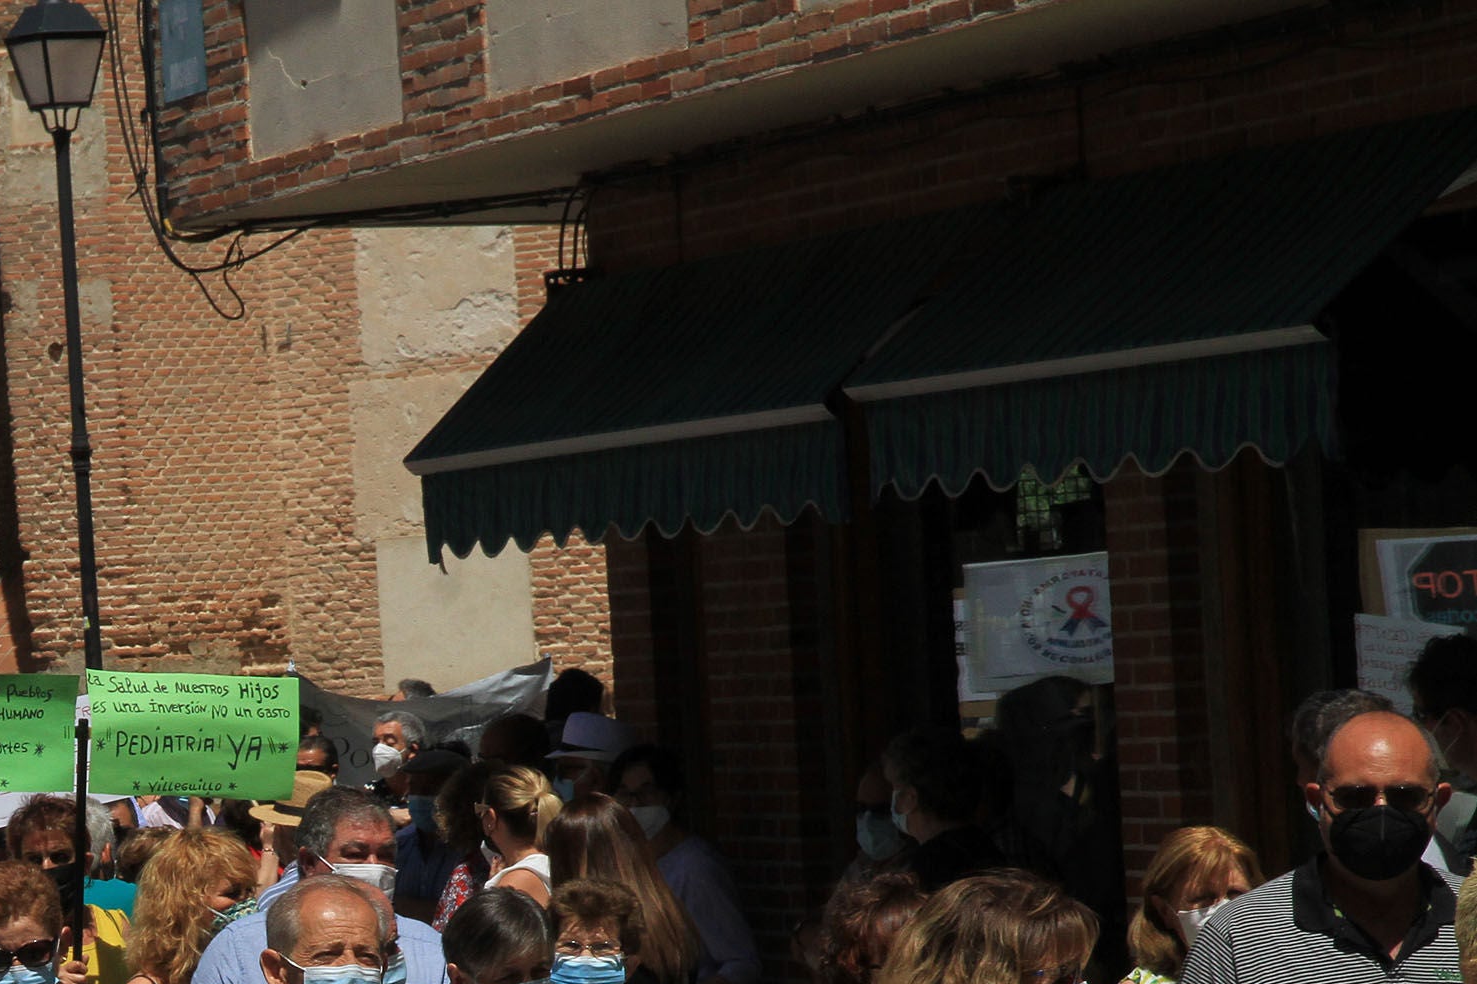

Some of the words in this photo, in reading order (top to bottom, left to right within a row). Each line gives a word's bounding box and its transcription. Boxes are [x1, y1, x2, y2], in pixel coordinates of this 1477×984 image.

[108, 676, 150, 693] Salud
[153, 679, 169, 693] de
[239, 682, 280, 704] Hijos
[211, 707, 227, 719] NO
